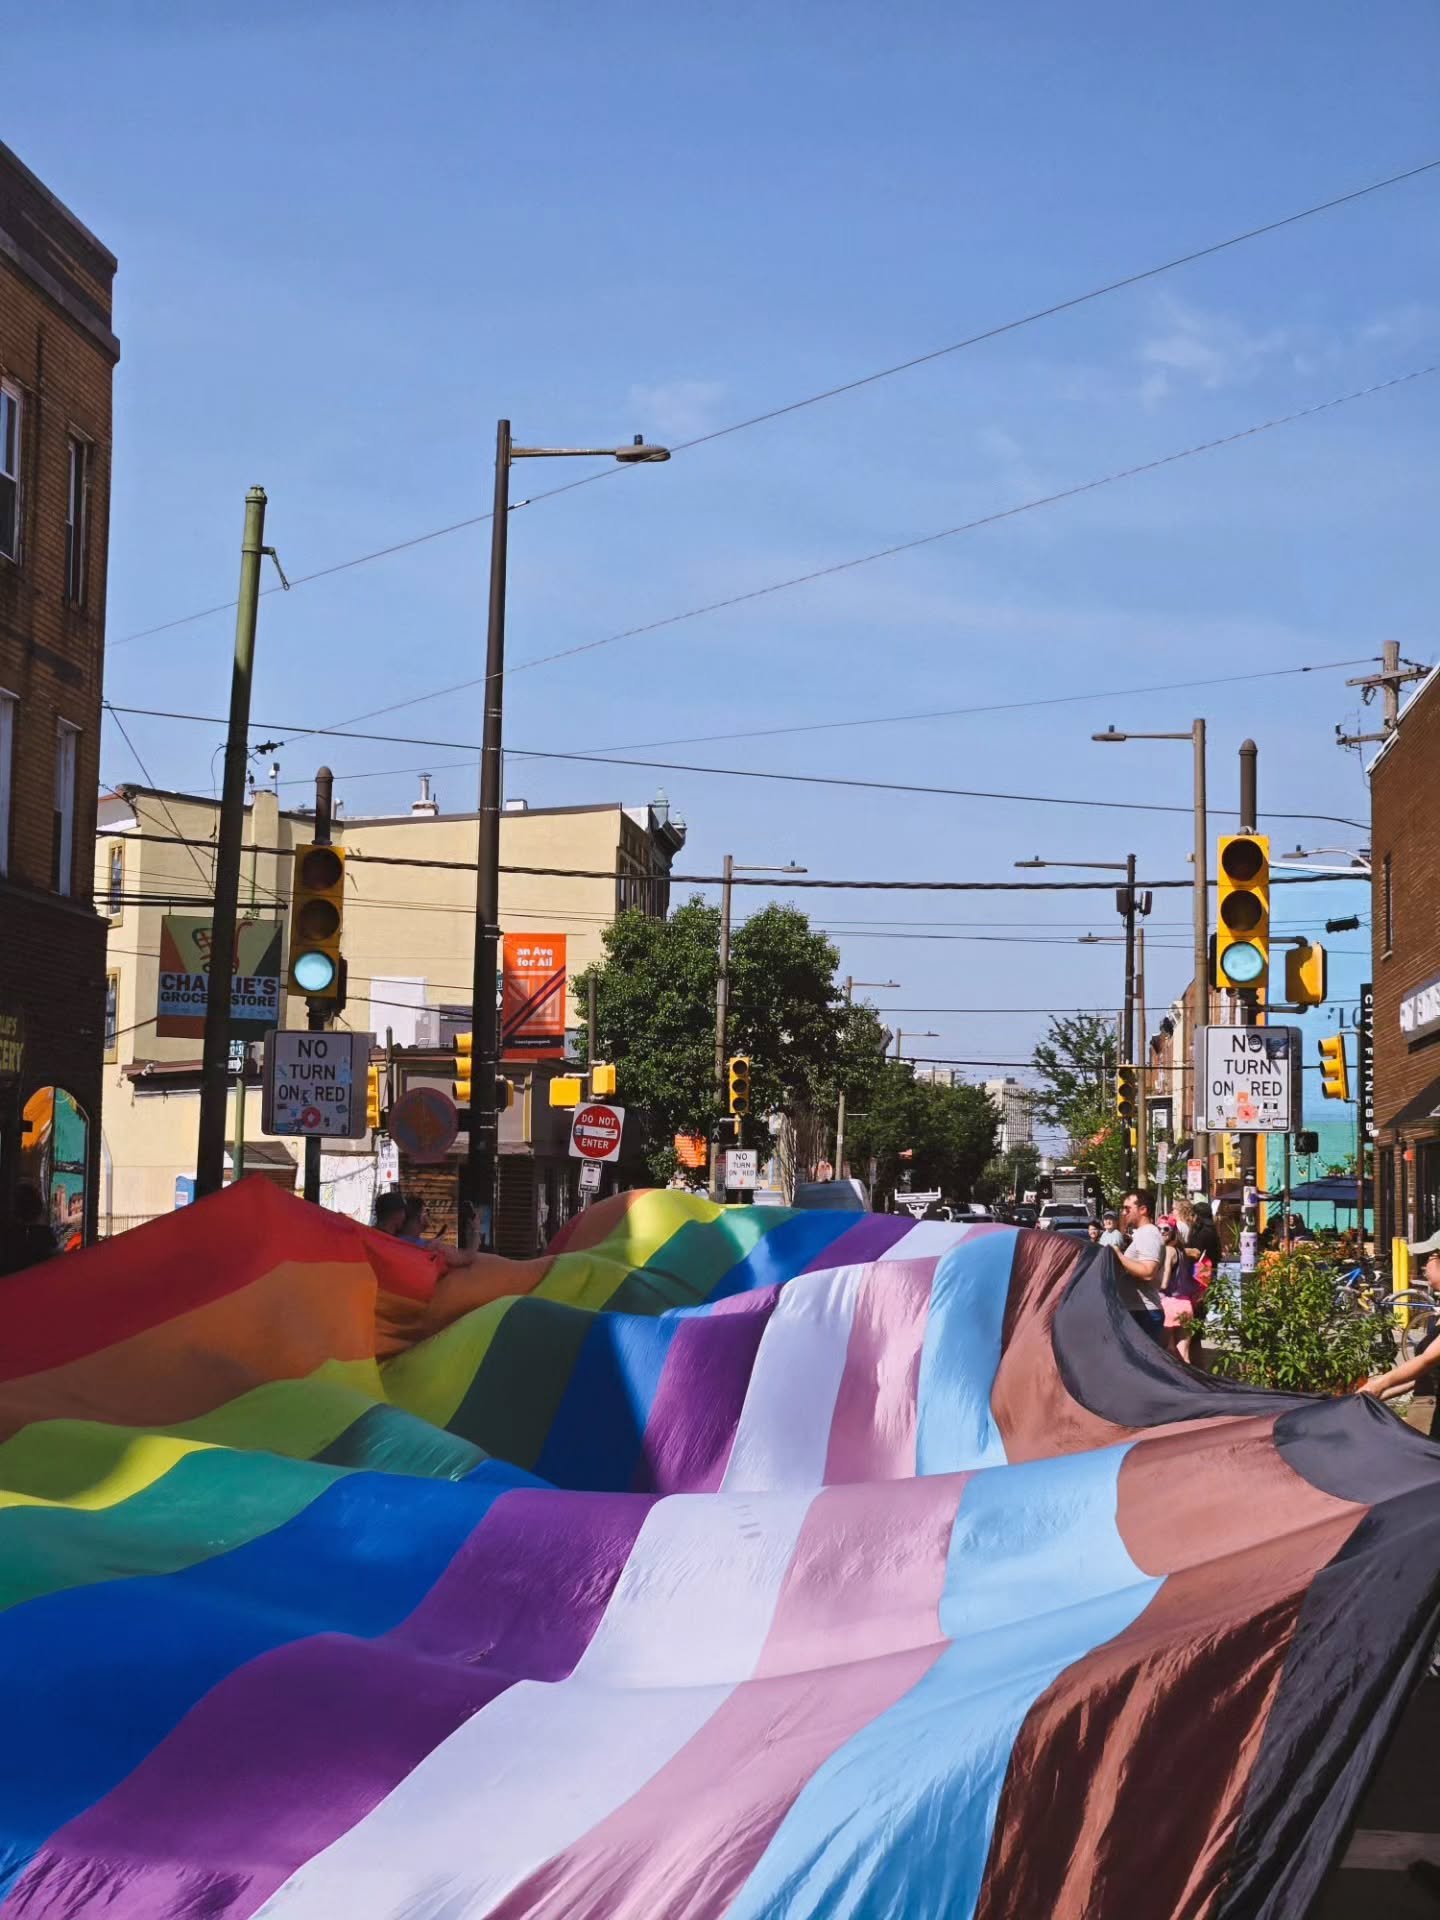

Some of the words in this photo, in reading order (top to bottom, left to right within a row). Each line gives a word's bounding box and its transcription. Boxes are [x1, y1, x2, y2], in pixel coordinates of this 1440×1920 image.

[516, 948, 531, 956] an
[533, 947, 553, 956] Ave
[517, 957, 535, 967] for
[537, 957, 553, 967] All
[161, 974, 277, 995] CHAIE'S
[161, 992, 209, 1004] GROCE
[231, 995, 276, 1007] STORE
[1364, 993, 1374, 1038] CITY
[298, 1040, 328, 1058] NO
[1232, 1034, 1263, 1053] NO
[289, 1064, 336, 1080] TURN
[1223, 1059, 1271, 1075] TURN
[278, 1085, 299, 1100] ON
[315, 1086, 345, 1102] RED
[1212, 1081, 1234, 1096] ON
[1251, 1081, 1282, 1097] RED
[581, 1114, 594, 1124] DO
[598, 1116, 616, 1127] NOT
[581, 1138, 609, 1149] ENTER
[735, 1152, 748, 1161] NO
